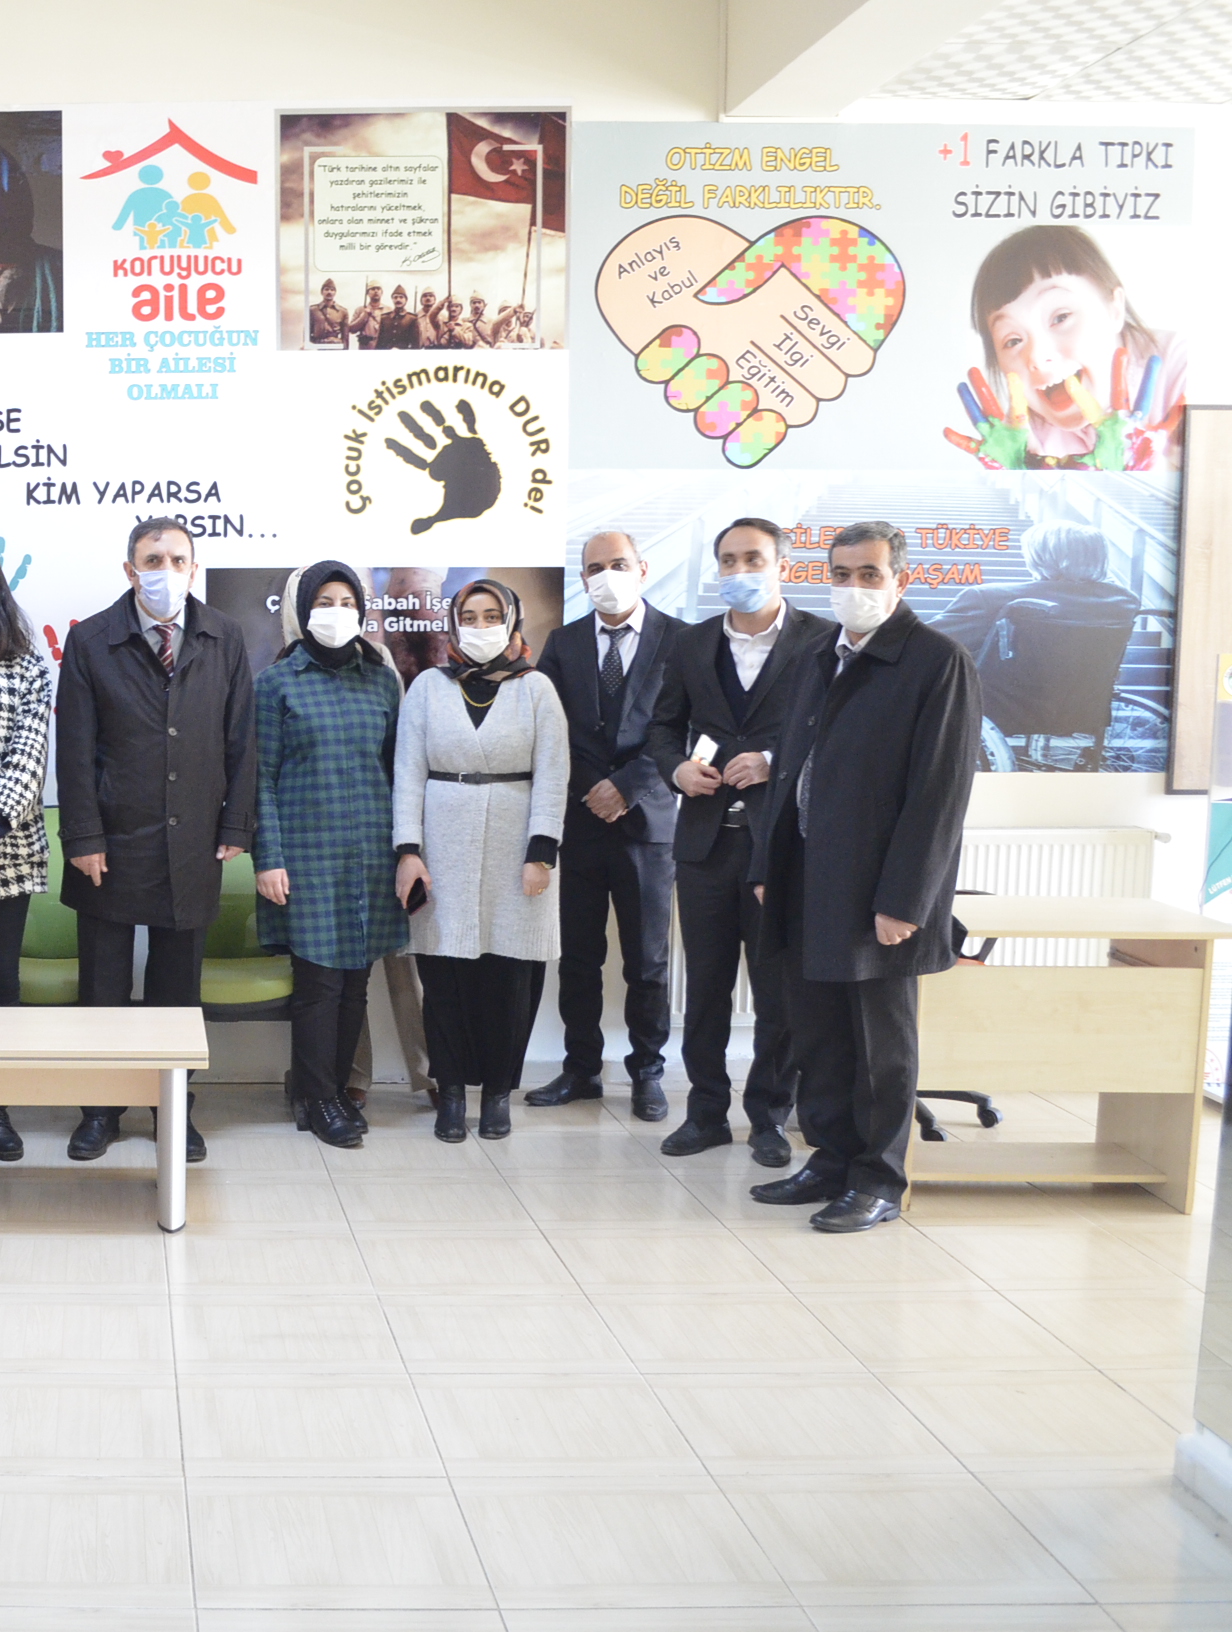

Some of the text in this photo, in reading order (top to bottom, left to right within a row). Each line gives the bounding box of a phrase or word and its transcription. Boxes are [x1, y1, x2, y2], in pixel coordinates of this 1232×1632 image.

[665, 142, 840, 172] OTİZM ENGEL
[937, 131, 1174, 170] +1 FARKLA TIPKI
[328, 177, 427, 188] yazdıran gazilerimiz ile
[345, 164, 378, 173] tarihine
[381, 163, 401, 172] altın
[403, 163, 439, 175] sayfalar
[330, 201, 426, 213] hatıralarını yüceltmek,
[352, 190, 409, 200] şehitlerimizin
[619, 178, 882, 210] DEĞİL FARKLILIKTIR.
[951, 183, 1162, 220] SİZİN GİBİYİZ
[317, 217, 344, 225] onlara
[346, 217, 364, 225] olan
[411, 215, 439, 226] şükran
[323, 229, 433, 240] duygularımızı ifade etmek
[339, 243, 356, 251] milli
[359, 242, 372, 251] bir
[616, 235, 682, 280] Anlayış
[646, 264, 671, 283] ve
[131, 282, 226, 323] aile
[645, 269, 699, 309] Kabul
[85, 325, 260, 353] HER ÇOCUĞUN
[792, 304, 851, 352] Sevgi
[108, 351, 237, 375] BİR AİLESİ
[772, 331, 814, 369] İlgi
[126, 383, 219, 401] OLMALI
[734, 349, 795, 408] Eğitim
[508, 394, 551, 458] DUR
[343, 428, 373, 515] Çocuk
[25, 476, 222, 506] KİM YAPARSA
[523, 467, 554, 515] de!
[916, 524, 1011, 550] TÜKİYE
